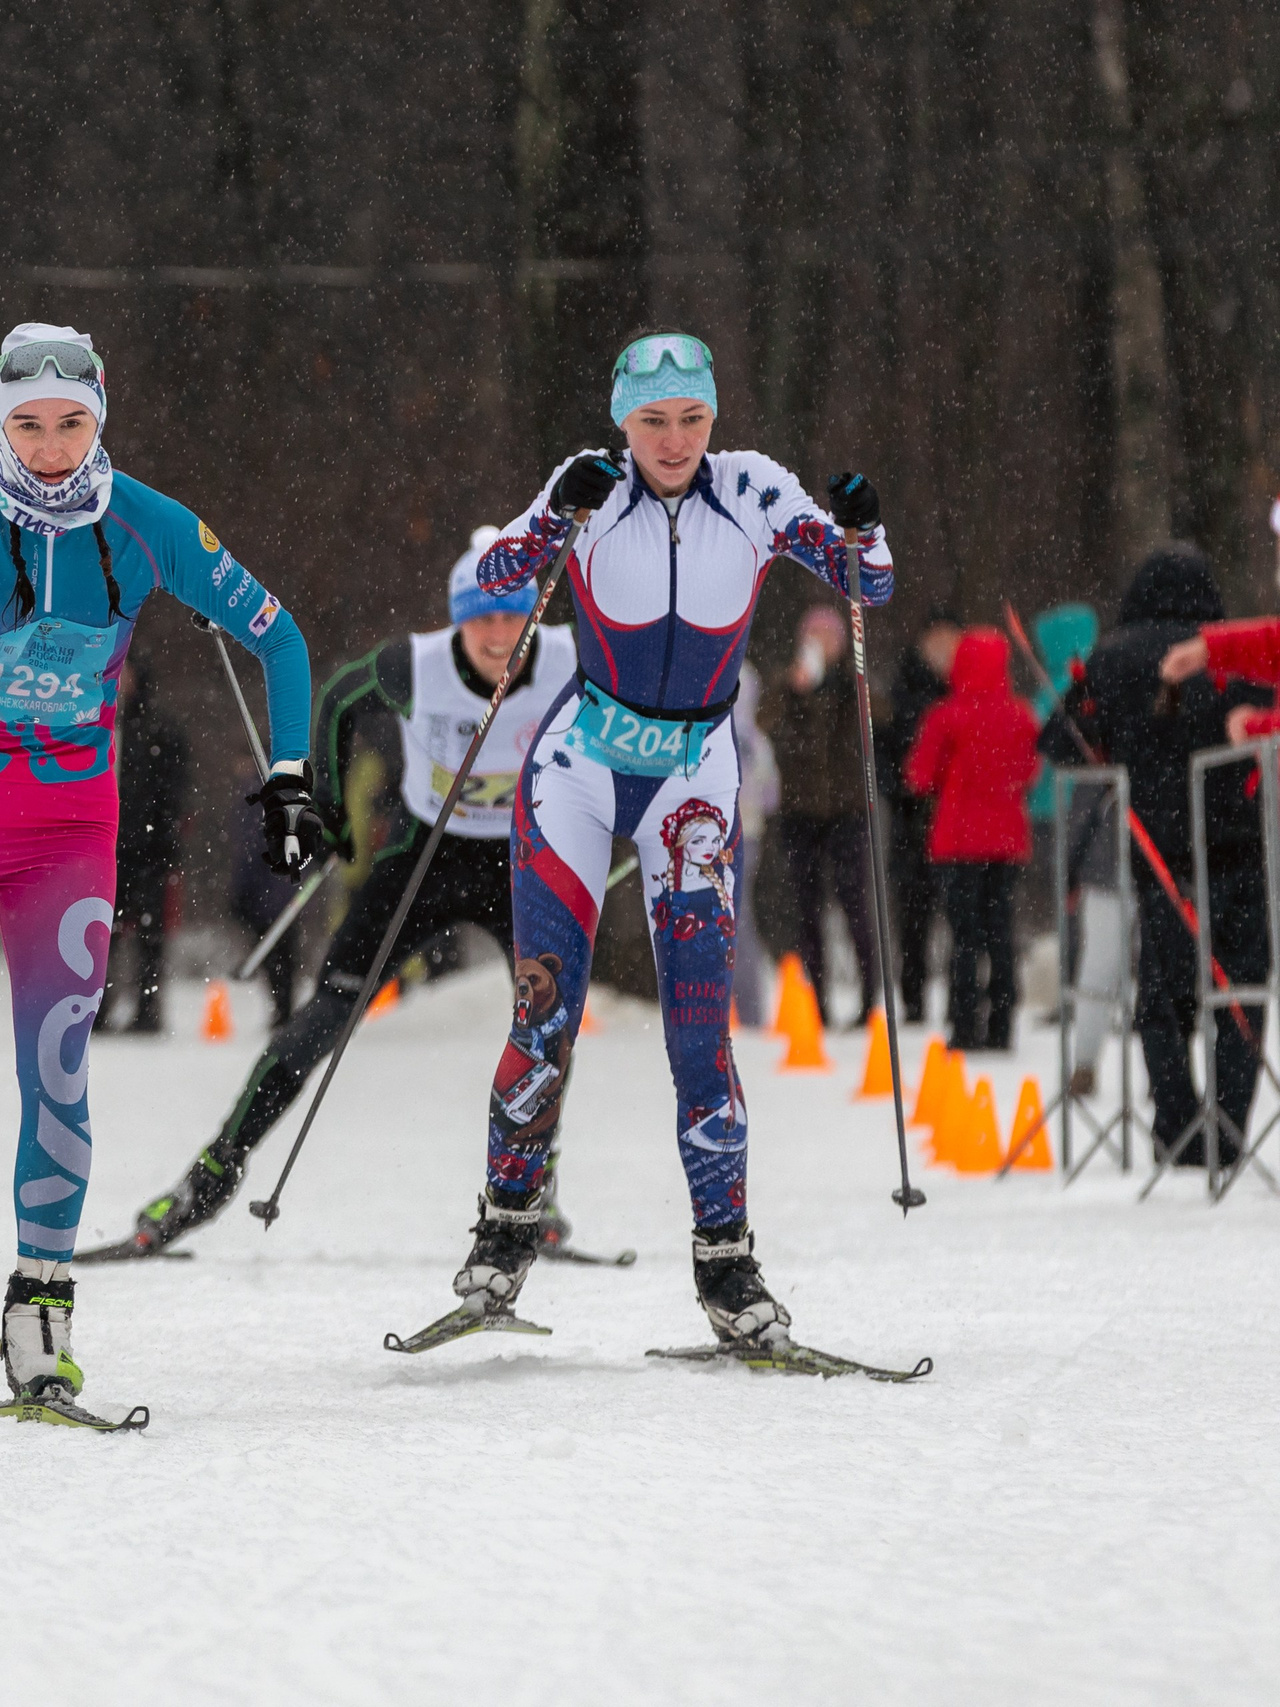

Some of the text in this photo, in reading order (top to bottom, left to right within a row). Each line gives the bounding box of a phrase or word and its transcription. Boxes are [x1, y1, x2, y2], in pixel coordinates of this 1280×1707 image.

[29, 641, 75, 657] ЛЫЖНЯ
[28, 650, 73, 665] РОССИИ
[41, 701, 77, 713] ОБЛАСТЬ
[600, 705, 684, 757] 1204
